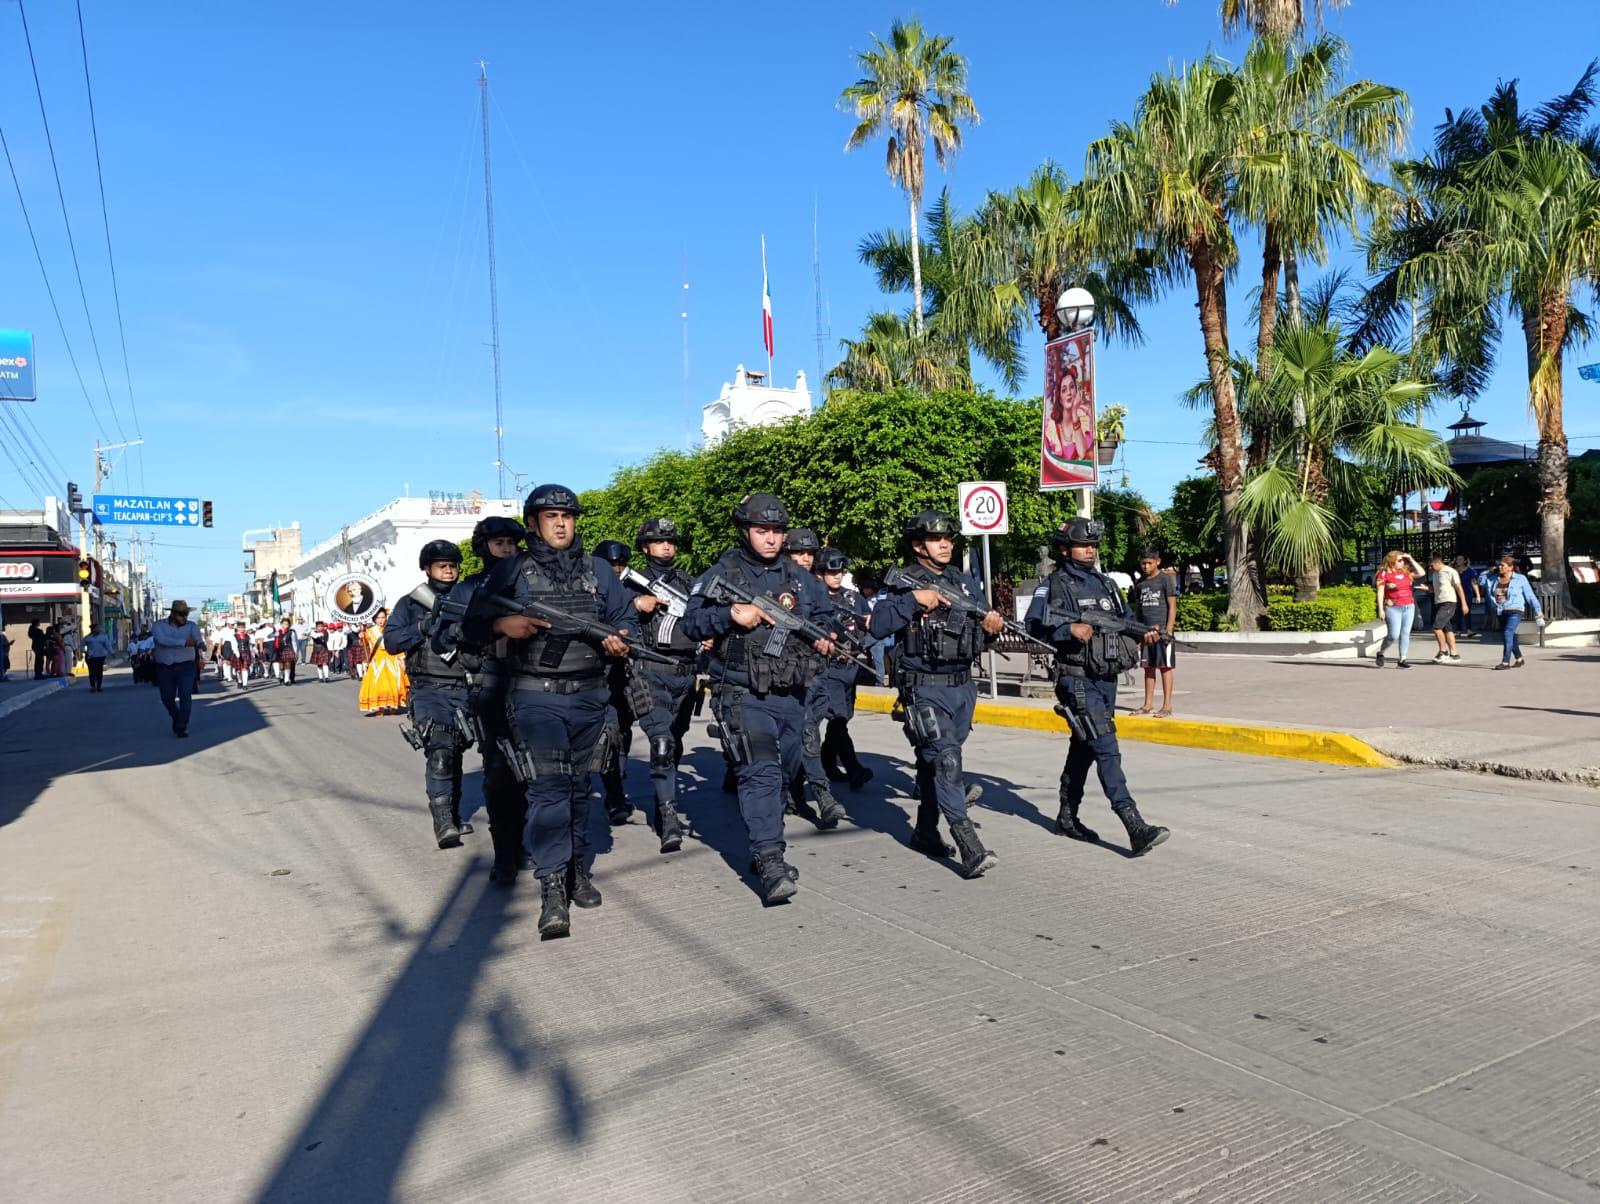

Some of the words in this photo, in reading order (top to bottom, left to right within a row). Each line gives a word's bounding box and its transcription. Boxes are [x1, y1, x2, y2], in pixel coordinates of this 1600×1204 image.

[113, 499, 171, 510] MAZATLAN
[975, 496, 995, 514] 20
[332, 609, 359, 622] IGNACIO
